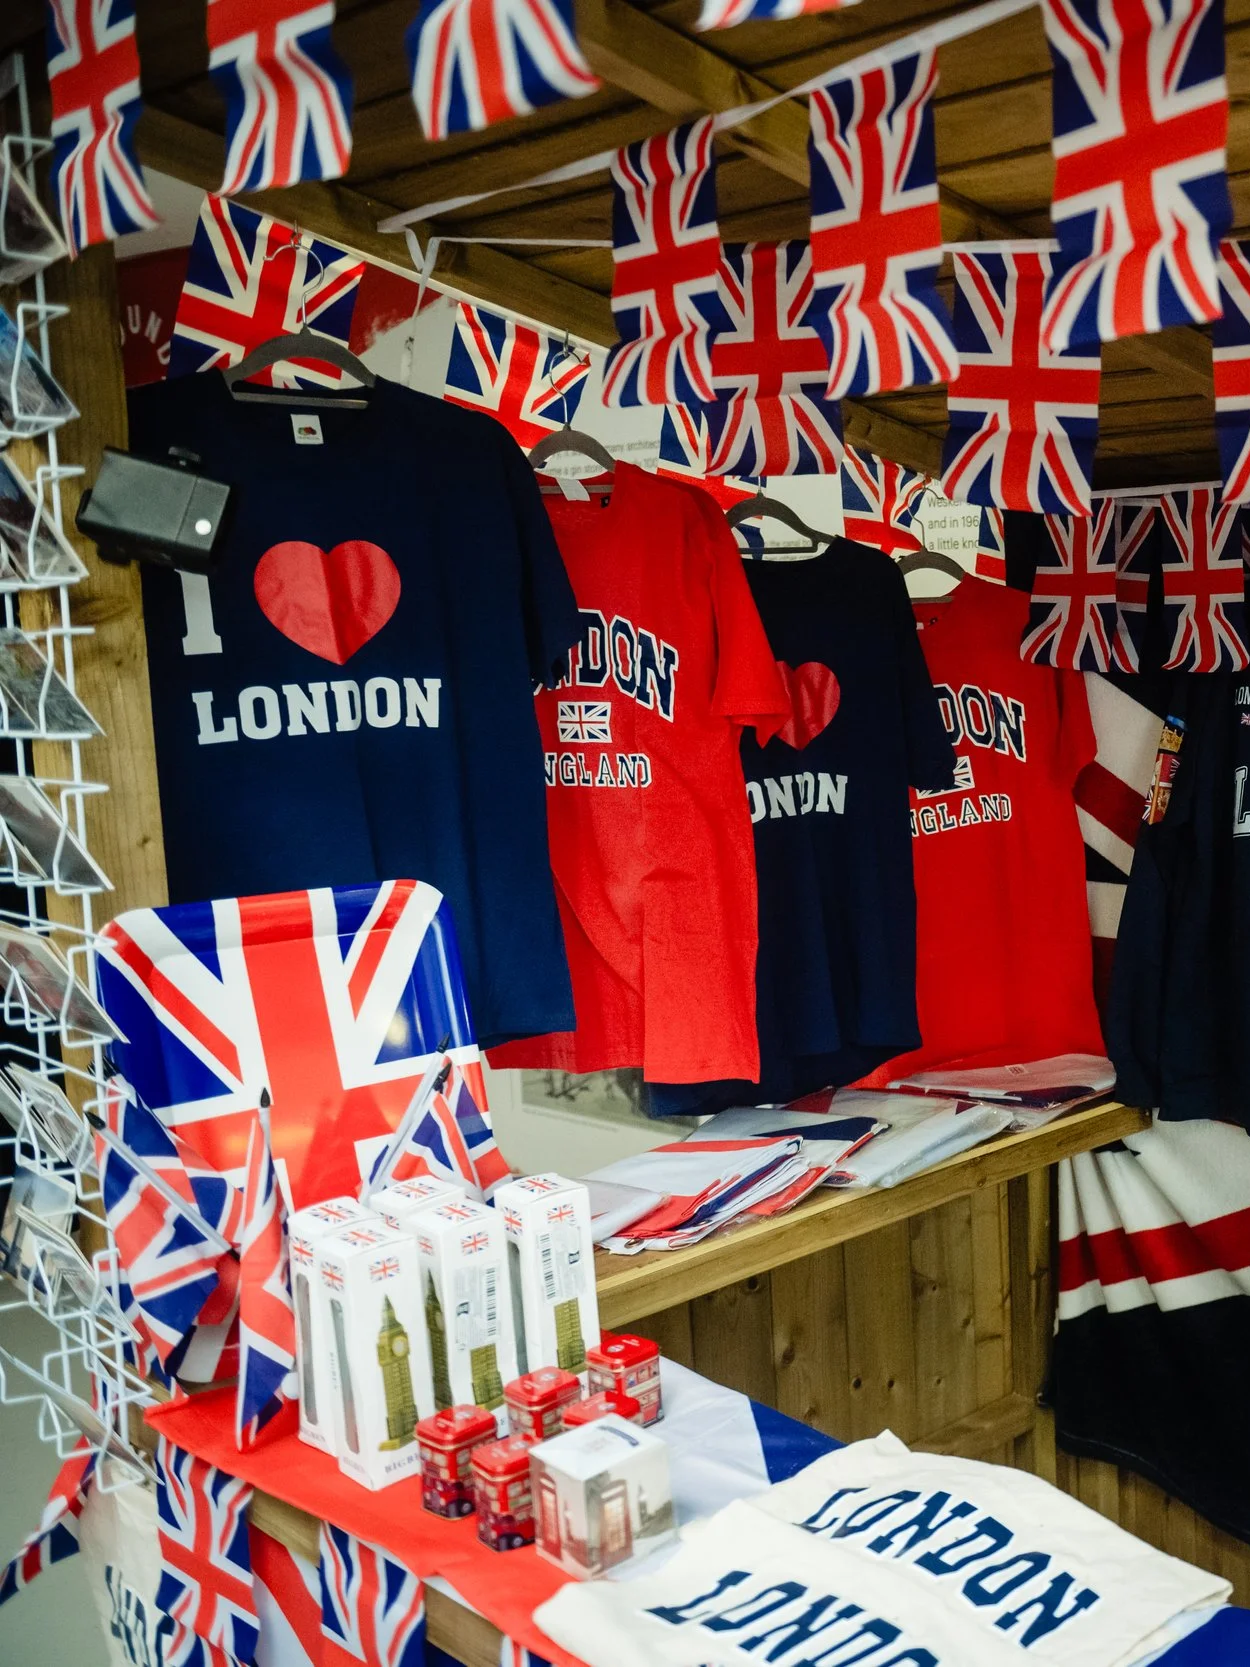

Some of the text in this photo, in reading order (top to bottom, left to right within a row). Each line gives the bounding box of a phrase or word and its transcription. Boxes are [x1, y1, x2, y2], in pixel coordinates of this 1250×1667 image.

[928, 515, 980, 530] and in 196
[928, 542, 935, 551] a
[938, 538, 959, 550] little
[174, 568, 223, 656] I
[191, 676, 442, 746] LONDON
[791, 1486, 1101, 1649] LONDON
